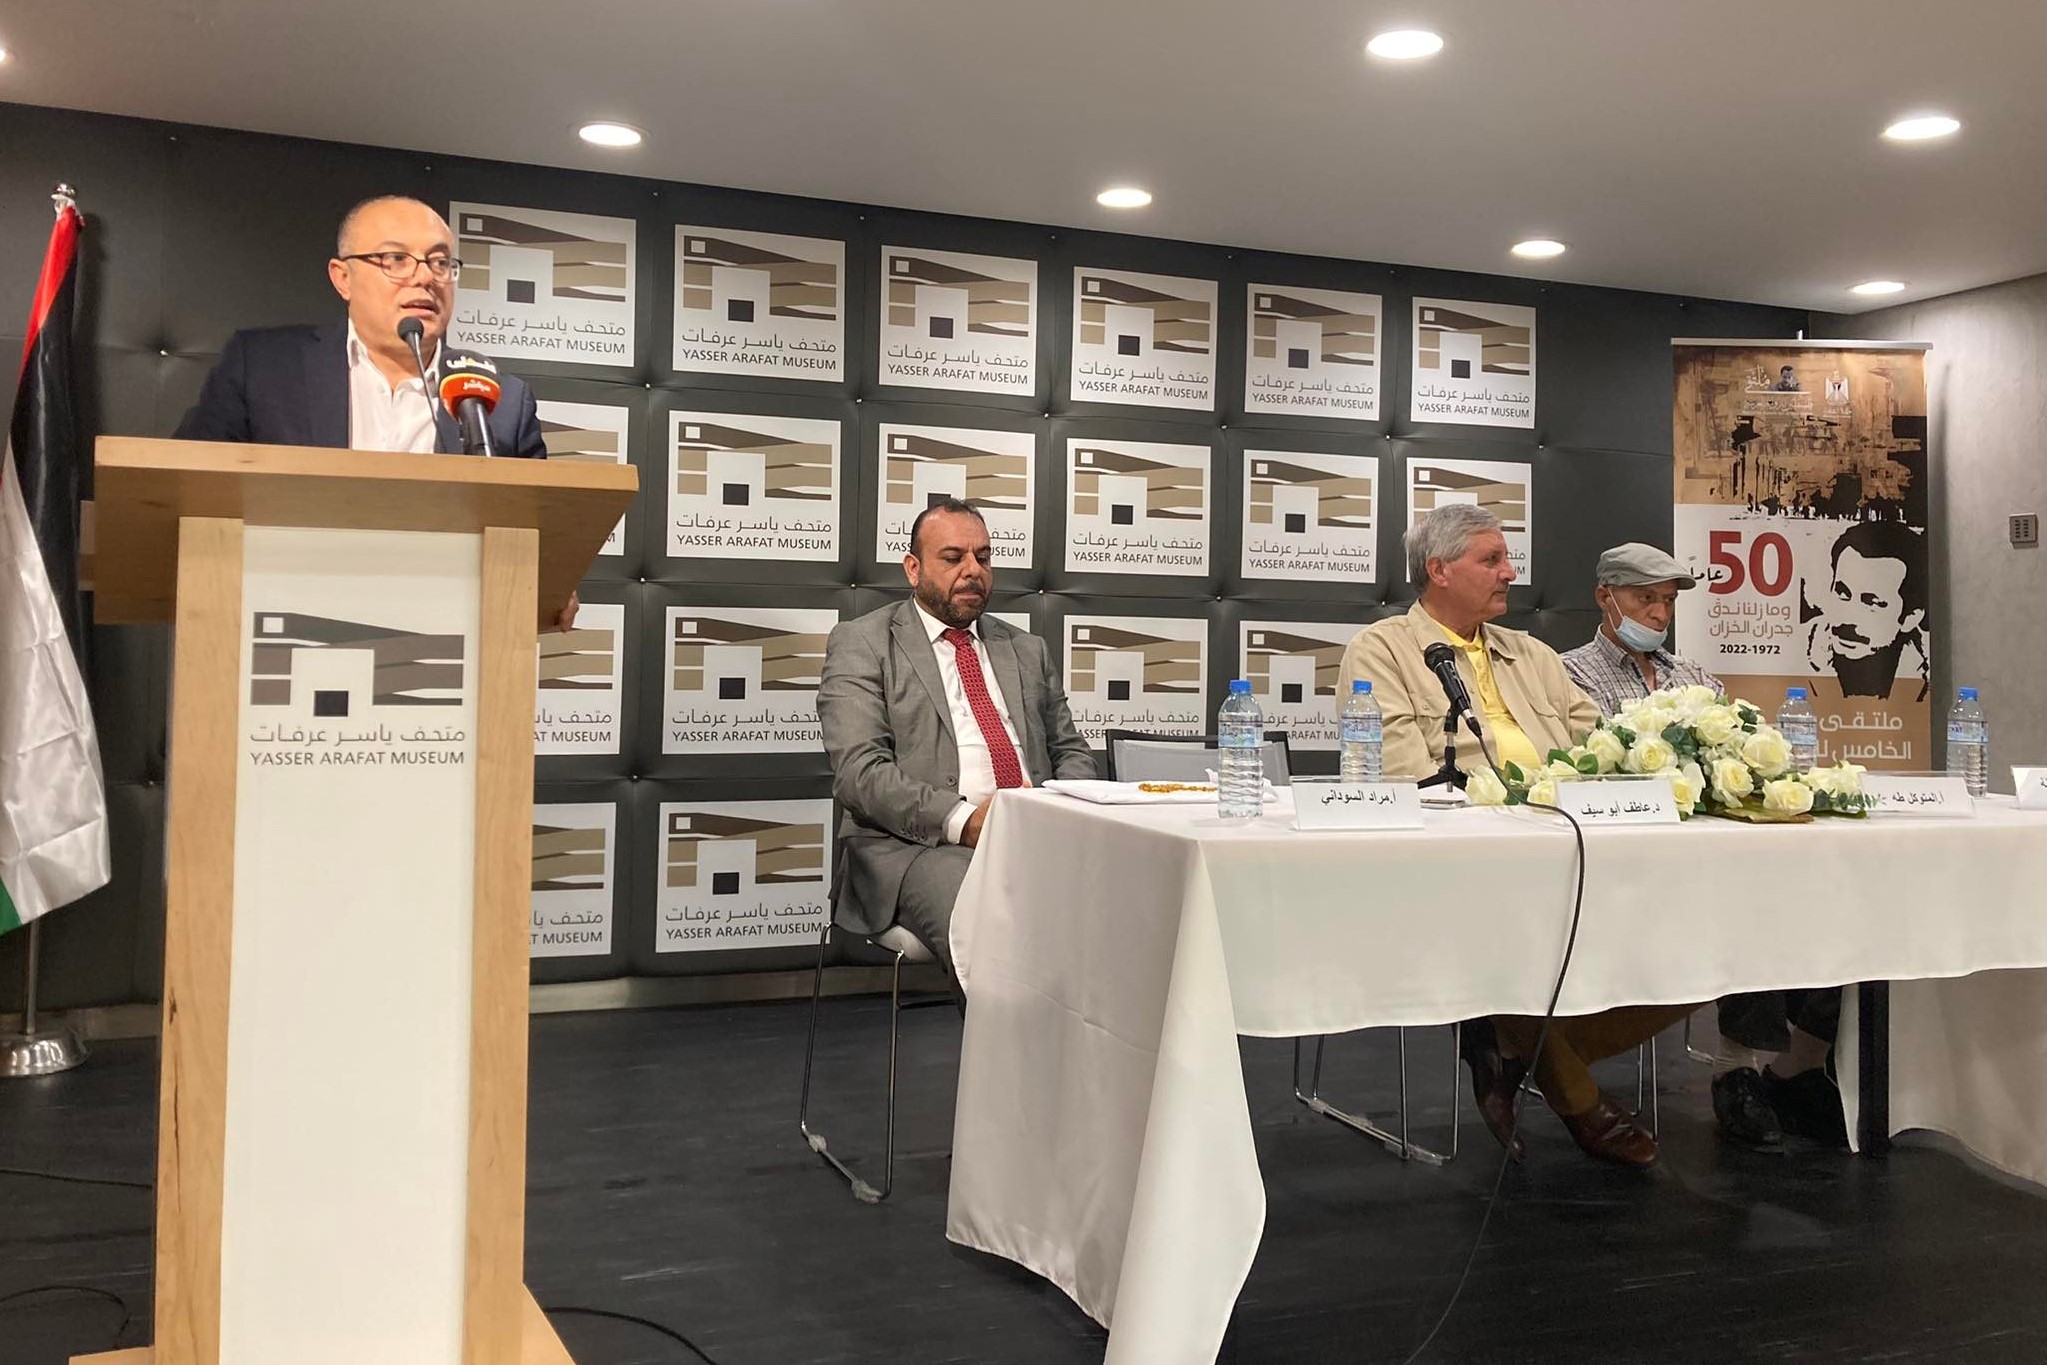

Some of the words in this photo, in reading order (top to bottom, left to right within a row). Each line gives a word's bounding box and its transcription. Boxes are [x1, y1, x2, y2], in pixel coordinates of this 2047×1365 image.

[456, 309, 516, 331] عرفات
[521, 315, 567, 335] ياسر
[573, 320, 626, 336] متحف
[457, 331, 507, 345] YASSER
[510, 335, 562, 349] ARAFAT
[566, 339, 625, 354] MUSEUM
[681, 328, 737, 349] عرفات
[741, 333, 784, 352] ياسر
[788, 339, 837, 353] متحف
[682, 348, 728, 362] YASSER
[731, 352, 780, 366] ARAFAT
[782, 356, 836, 370] MUSEUM
[887, 343, 937, 364] عرفات
[941, 349, 980, 367] ياسر
[984, 355, 1029, 369] متحف
[887, 363, 930, 377] YASSER
[932, 367, 976, 381] ARAFAT
[979, 371, 1028, 385] MUSEUM
[1078, 361, 1125, 380] عرفات
[1128, 366, 1165, 383] ياسر
[1168, 371, 1209, 384] متحف
[1078, 380, 1118, 393] YASSER
[1120, 383, 1161, 396] ARAFAT
[1163, 386, 1208, 400] MUSEUM
[1252, 373, 1295, 392] عرفات
[1297, 378, 1332, 393] ياسر
[1335, 383, 1374, 395] متحف
[1251, 392, 1289, 405] YASSER
[1290, 395, 1329, 407] ARAFAT
[1330, 398, 1374, 410] MUSEUM
[1417, 384, 1458, 402] عرفات
[1460, 388, 1492, 404] ياسر
[1495, 392, 1530, 404] متحف
[1417, 402, 1452, 414] YASSER
[1453, 404, 1489, 415] ARAFAT
[1490, 406, 1530, 419] MUSEUM
[676, 512, 732, 533] عرفات
[736, 515, 779, 534] ياسر
[784, 517, 832, 533] متحف
[676, 534, 723, 546] YASSER
[726, 536, 775, 548] ARAFAT
[777, 537, 832, 550] MUSEUM
[885, 541, 912, 553] YASS
[990, 546, 1026, 557] USEUM
[1072, 531, 1118, 550] عرفات
[1122, 534, 1158, 551] ياسر
[1162, 536, 1203, 550] متحف
[1248, 539, 1292, 557] عرفات
[1072, 551, 1112, 562] YASSER
[1113, 552, 1154, 564] ARAFAT
[1156, 554, 1203, 566] MUSEUM
[1294, 542, 1329, 559] ياسر
[1332, 543, 1371, 558] متحف
[1248, 558, 1285, 570] YASSER
[1287, 559, 1326, 571] ARAFAT
[1327, 561, 1370, 573] MUSEUM
[1709, 531, 1793, 597] 50
[1709, 620, 1750, 639] الخزان
[1752, 621, 1793, 639] جدران
[1719, 644, 1781, 655] 2022-1972
[559, 709, 613, 724] متحف
[672, 708, 728, 728] عرفات
[732, 709, 775, 728] ياسر
[780, 710, 820, 723] تحف
[1118, 709, 1155, 727] ياسر
[1158, 710, 1200, 723] متحف
[1293, 711, 1325, 727] ياسر
[1819, 711, 1903, 732] ملتقى
[250, 723, 327, 747] عرفات
[334, 723, 392, 747] ياسر
[400, 726, 466, 742] متحف
[551, 731, 612, 742] MUSEUM
[672, 730, 719, 742] YASSER
[721, 730, 771, 742] ARAFAT
[250, 752, 314, 766] YASSER
[319, 751, 386, 765] ARAFAT
[390, 751, 465, 765] MUSEUM
[1832, 739, 1912, 762] الخامس
[1321, 789, 1365, 806] السوداني
[1581, 804, 1604, 817] سيف
[550, 910, 604, 926] متحف
[665, 905, 721, 925] عرفات
[725, 902, 769, 924] ياسر
[774, 902, 823, 917] متحف
[542, 931, 603, 944] MUSEUM
[665, 927, 712, 940] YASSER
[715, 924, 764, 938] ARAFAT
[767, 922, 822, 936] MUSEUM
